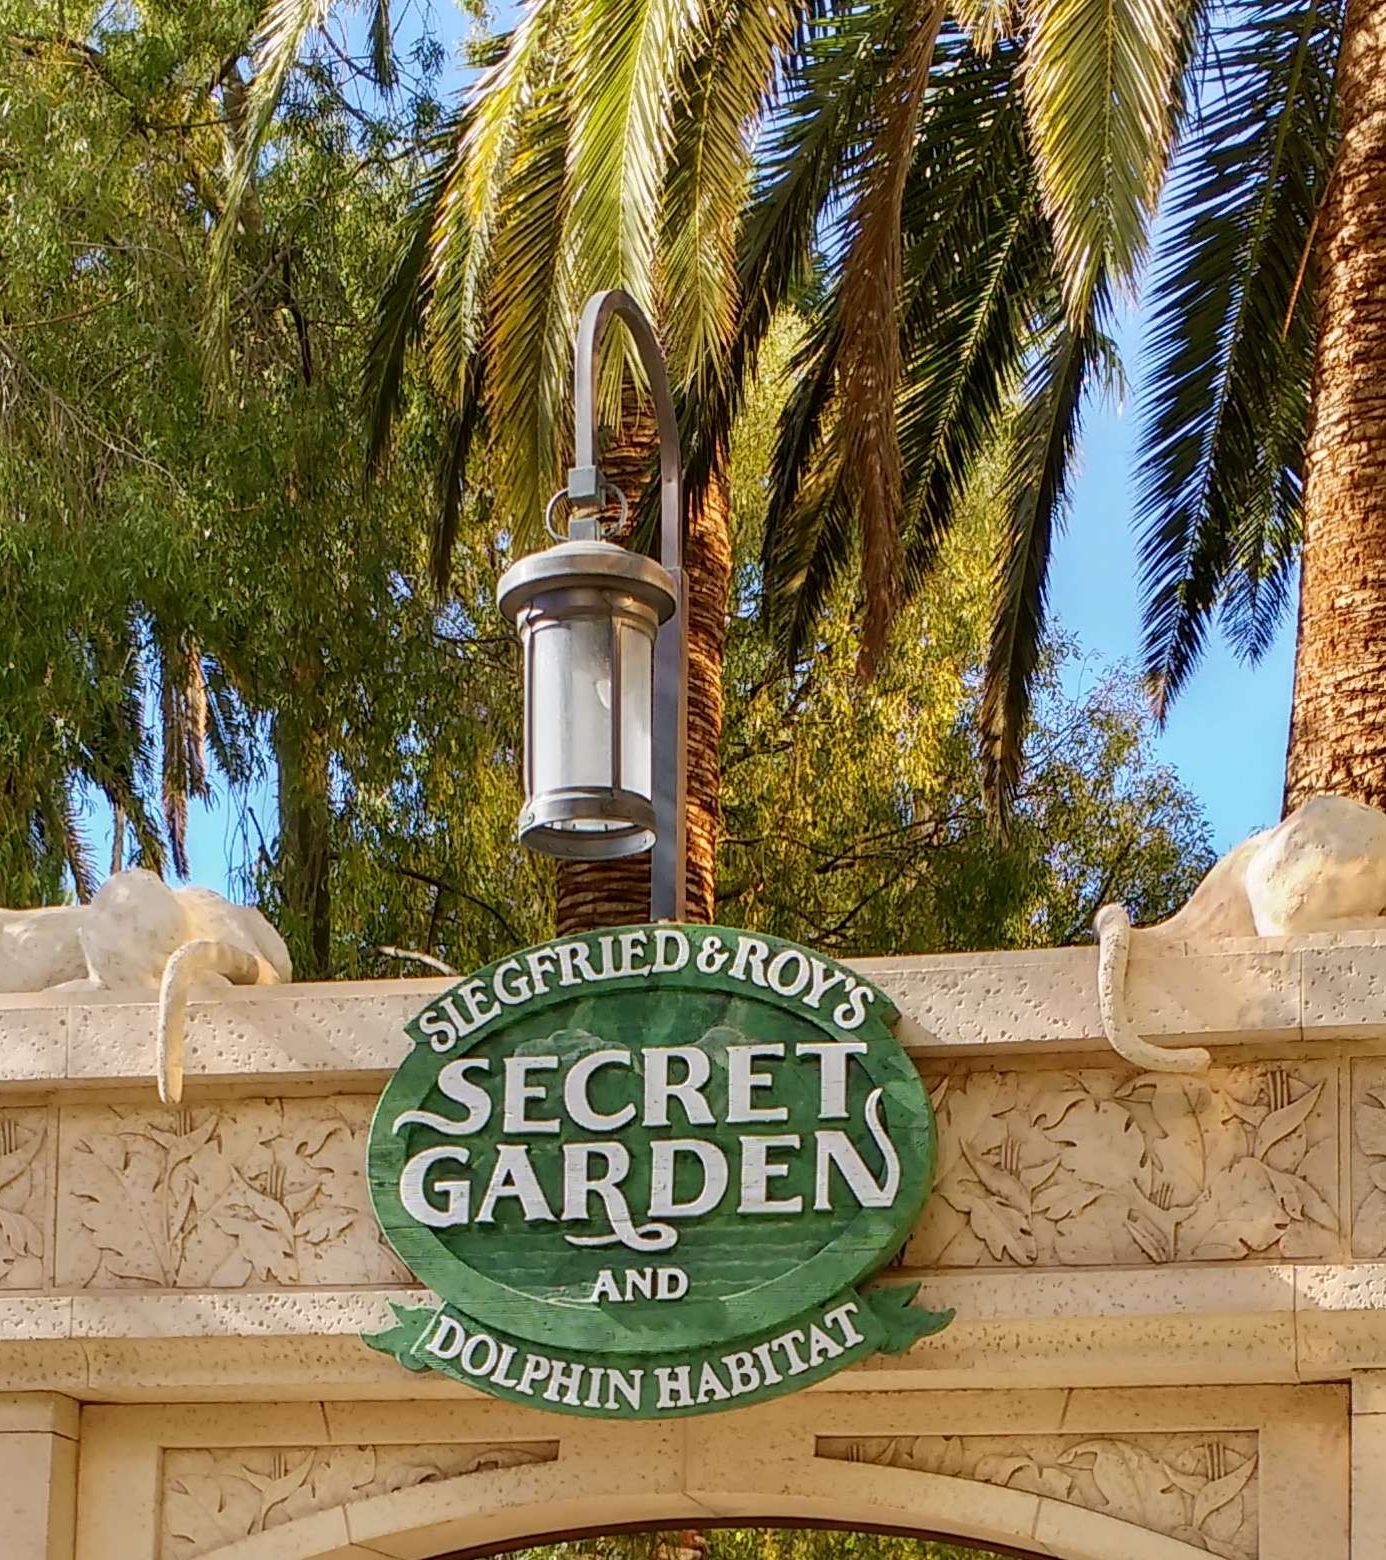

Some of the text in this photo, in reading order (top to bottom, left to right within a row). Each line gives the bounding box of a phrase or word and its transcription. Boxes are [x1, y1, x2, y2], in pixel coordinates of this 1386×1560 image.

[418, 929, 691, 1053] SIEGFRIED
[730, 934, 875, 1030] ROY'S
[392, 1042, 868, 1136] SECRET
[400, 1088, 900, 1252] GARDEN
[590, 1267, 689, 1303] AND
[426, 1302, 865, 1411] DOLPHIN HABITAT
